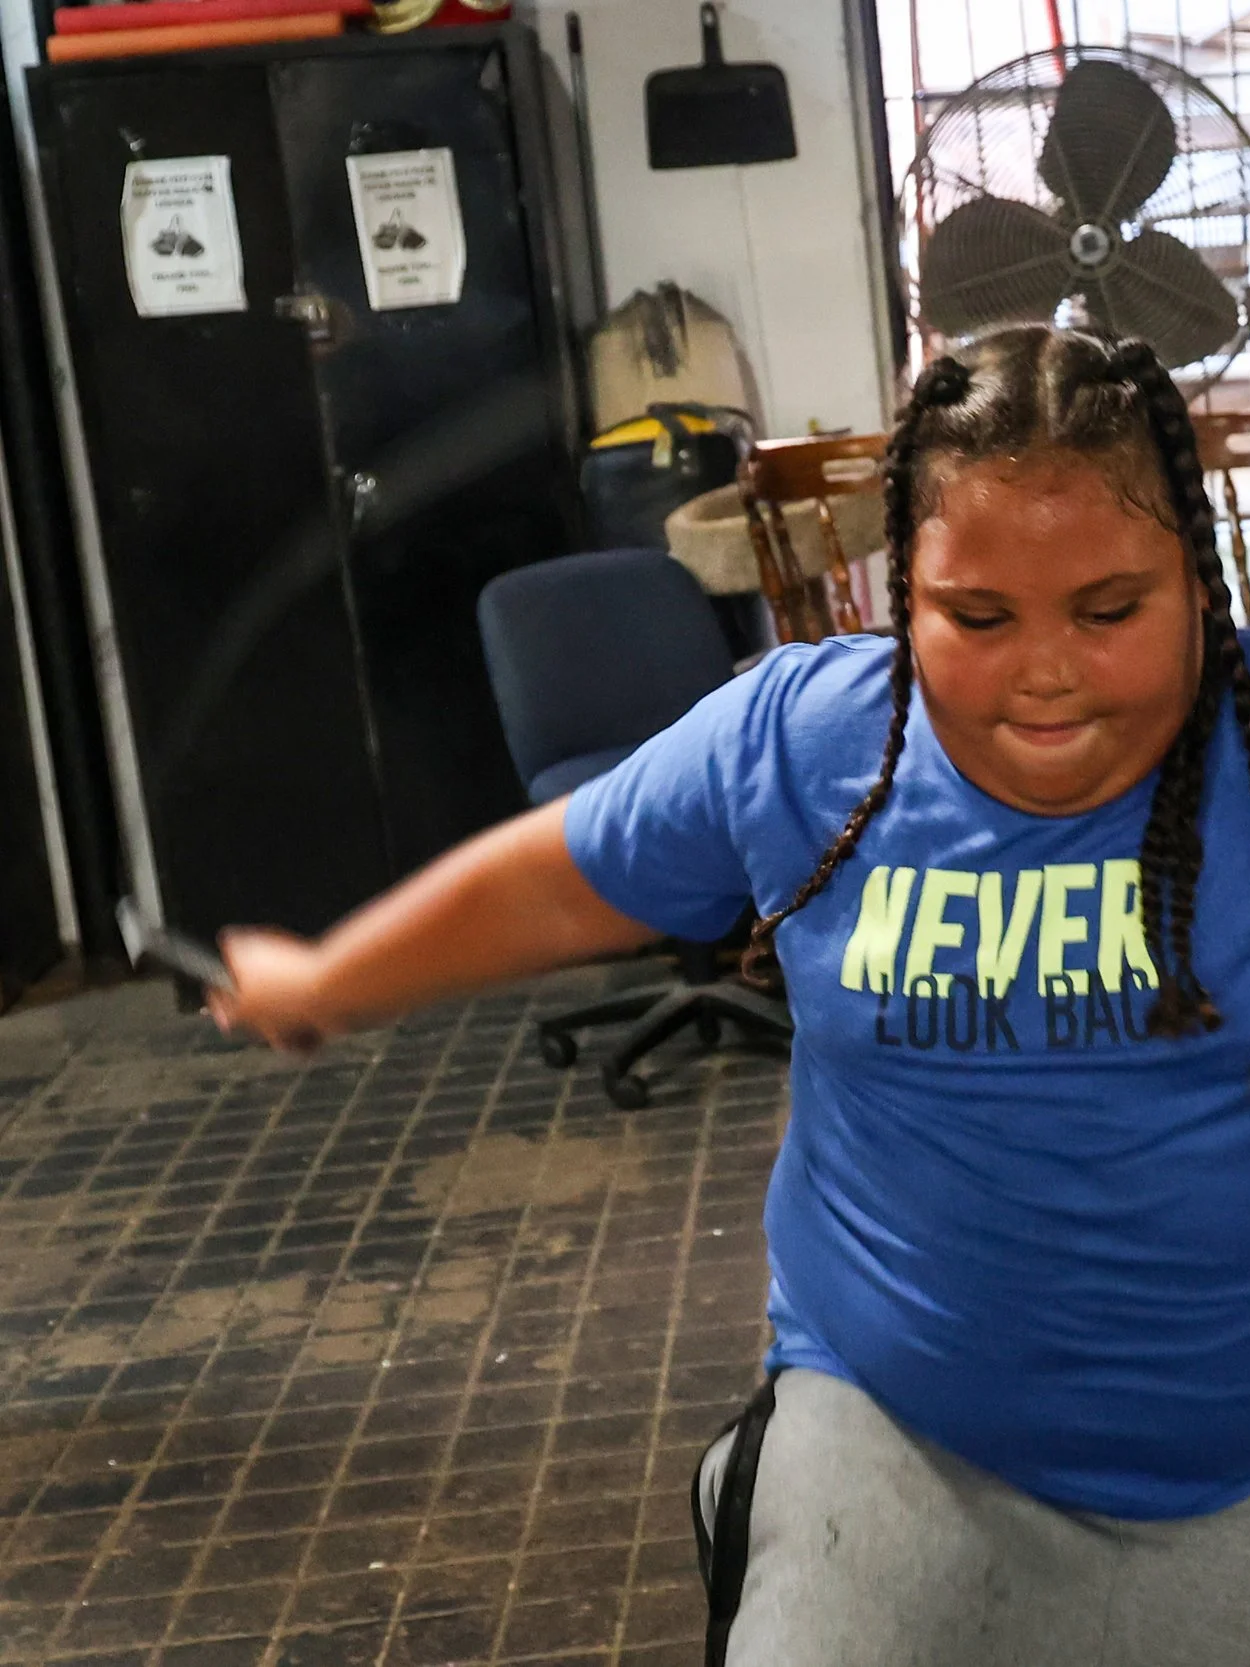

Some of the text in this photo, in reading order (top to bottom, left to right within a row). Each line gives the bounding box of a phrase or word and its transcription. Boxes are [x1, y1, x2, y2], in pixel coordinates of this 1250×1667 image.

[840, 858, 1160, 999] NEVER
[875, 969, 1151, 1050] LOOK BAC
